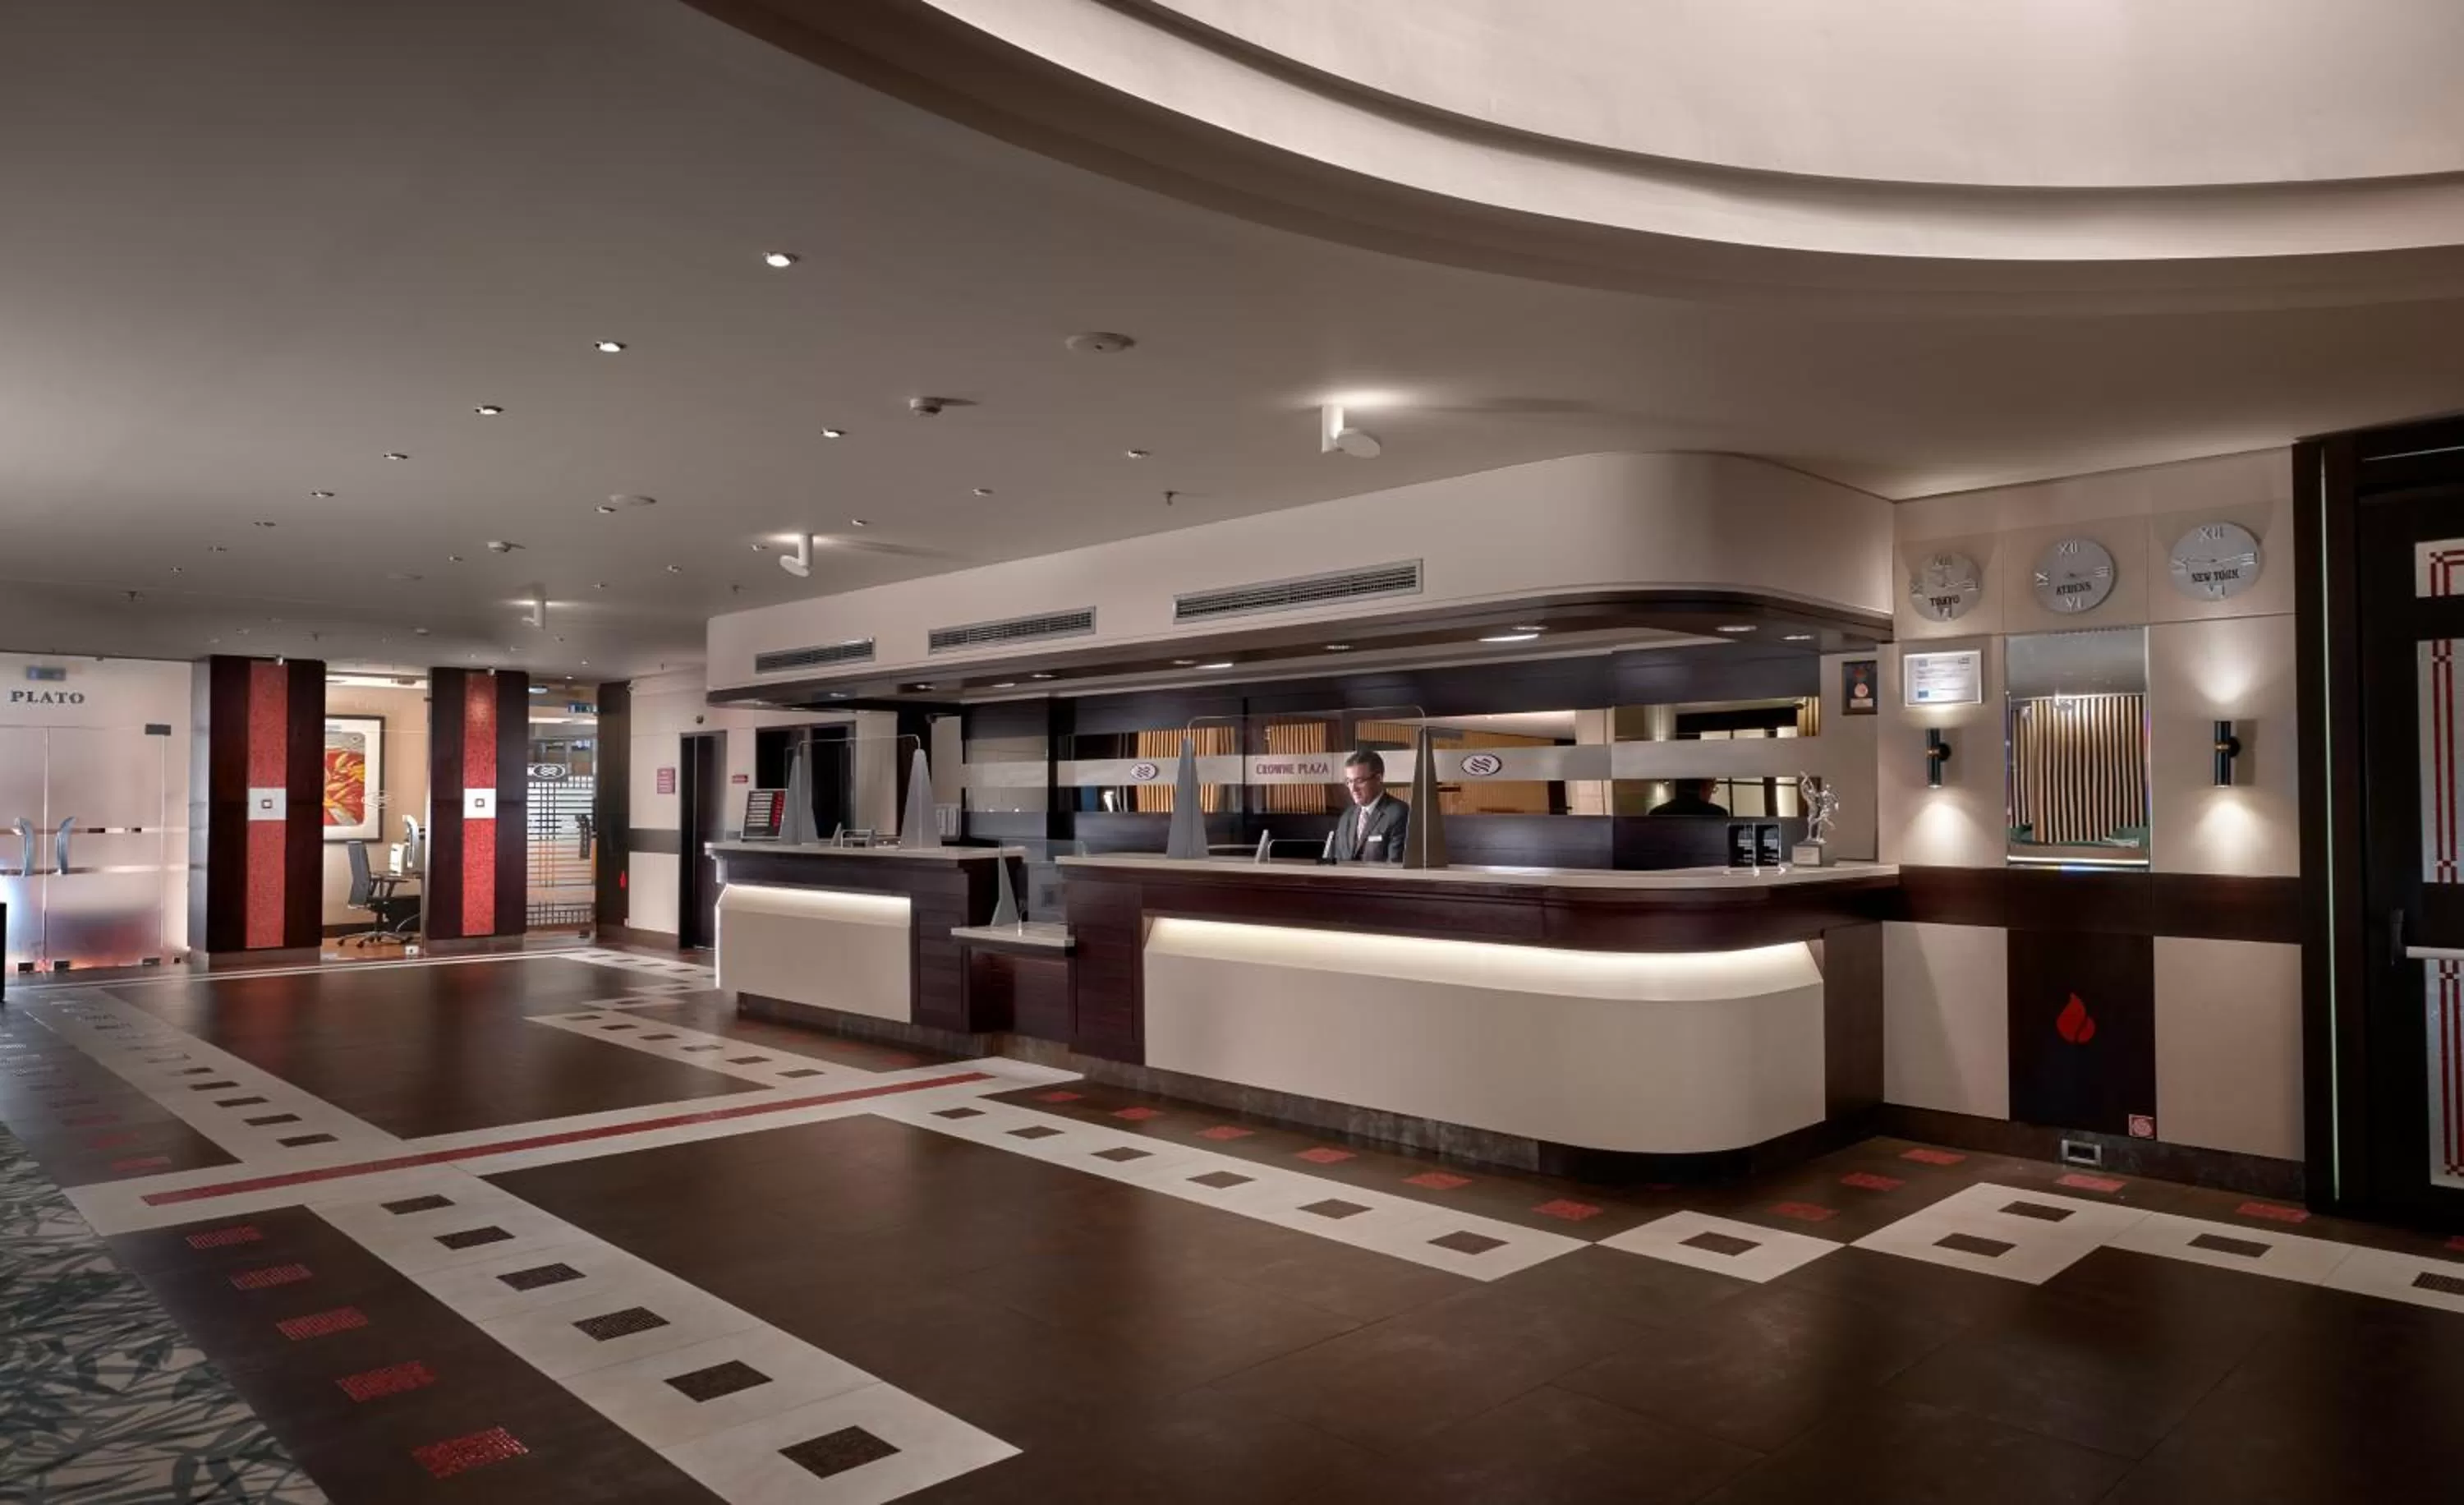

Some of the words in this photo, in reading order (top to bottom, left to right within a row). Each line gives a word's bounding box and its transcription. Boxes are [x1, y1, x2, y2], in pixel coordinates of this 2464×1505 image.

[2191, 571, 2211, 582] NEW
[2056, 581, 2091, 596] ATHENS
[10, 690, 85, 704] PLATO
[1257, 762, 1295, 775] CROWNE
[1298, 762, 1329, 775] PLAZA
